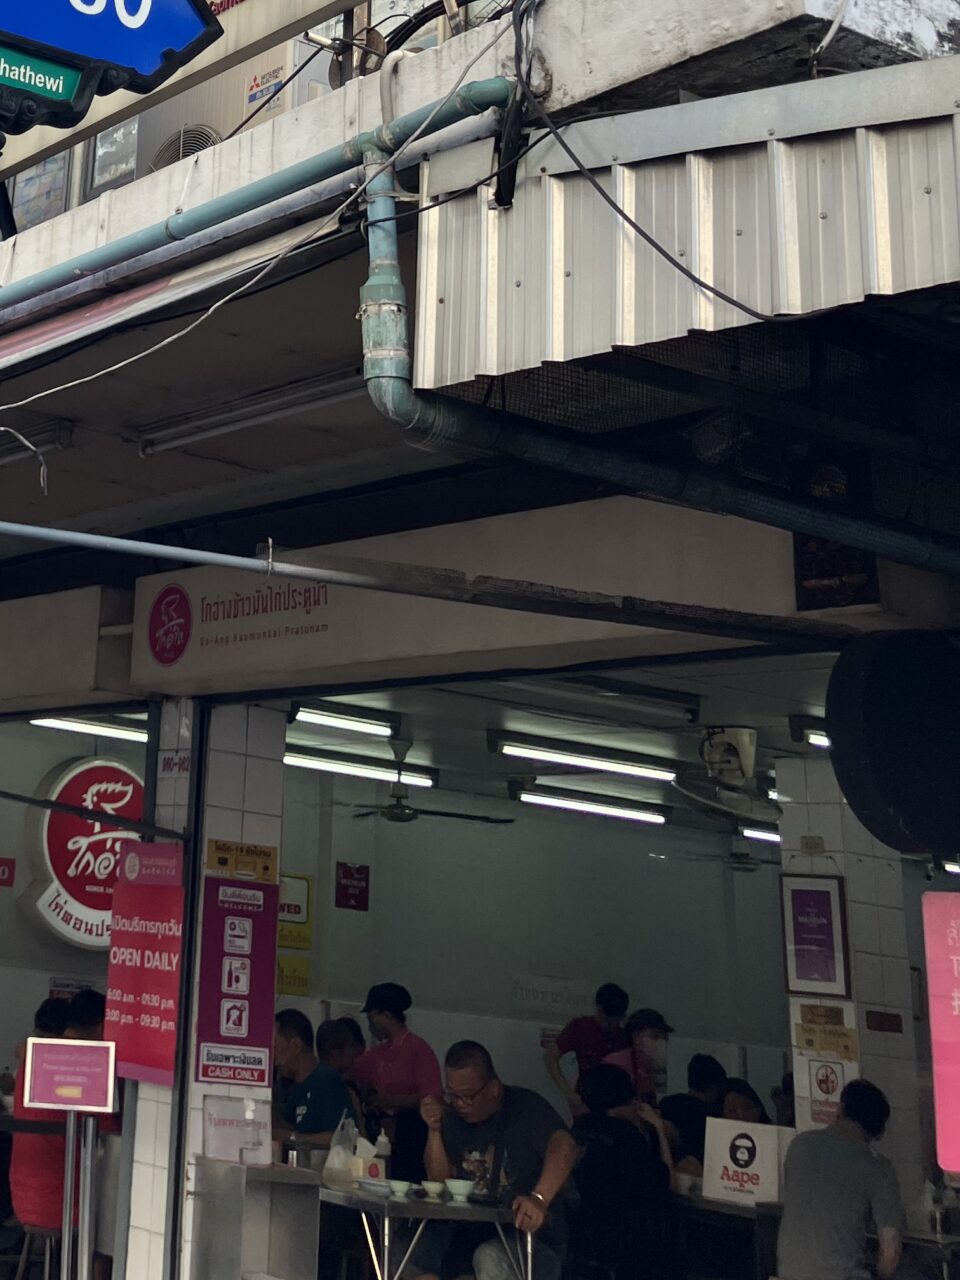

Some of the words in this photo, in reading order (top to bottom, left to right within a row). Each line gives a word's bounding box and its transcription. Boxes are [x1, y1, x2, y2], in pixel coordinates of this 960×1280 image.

[110, 946, 141, 967] OPEN
[144, 950, 179, 971] DAILY
[208, 1066, 234, 1078] CASH
[234, 1068, 260, 1081] ONLY
[719, 1165, 761, 1188] Aape
